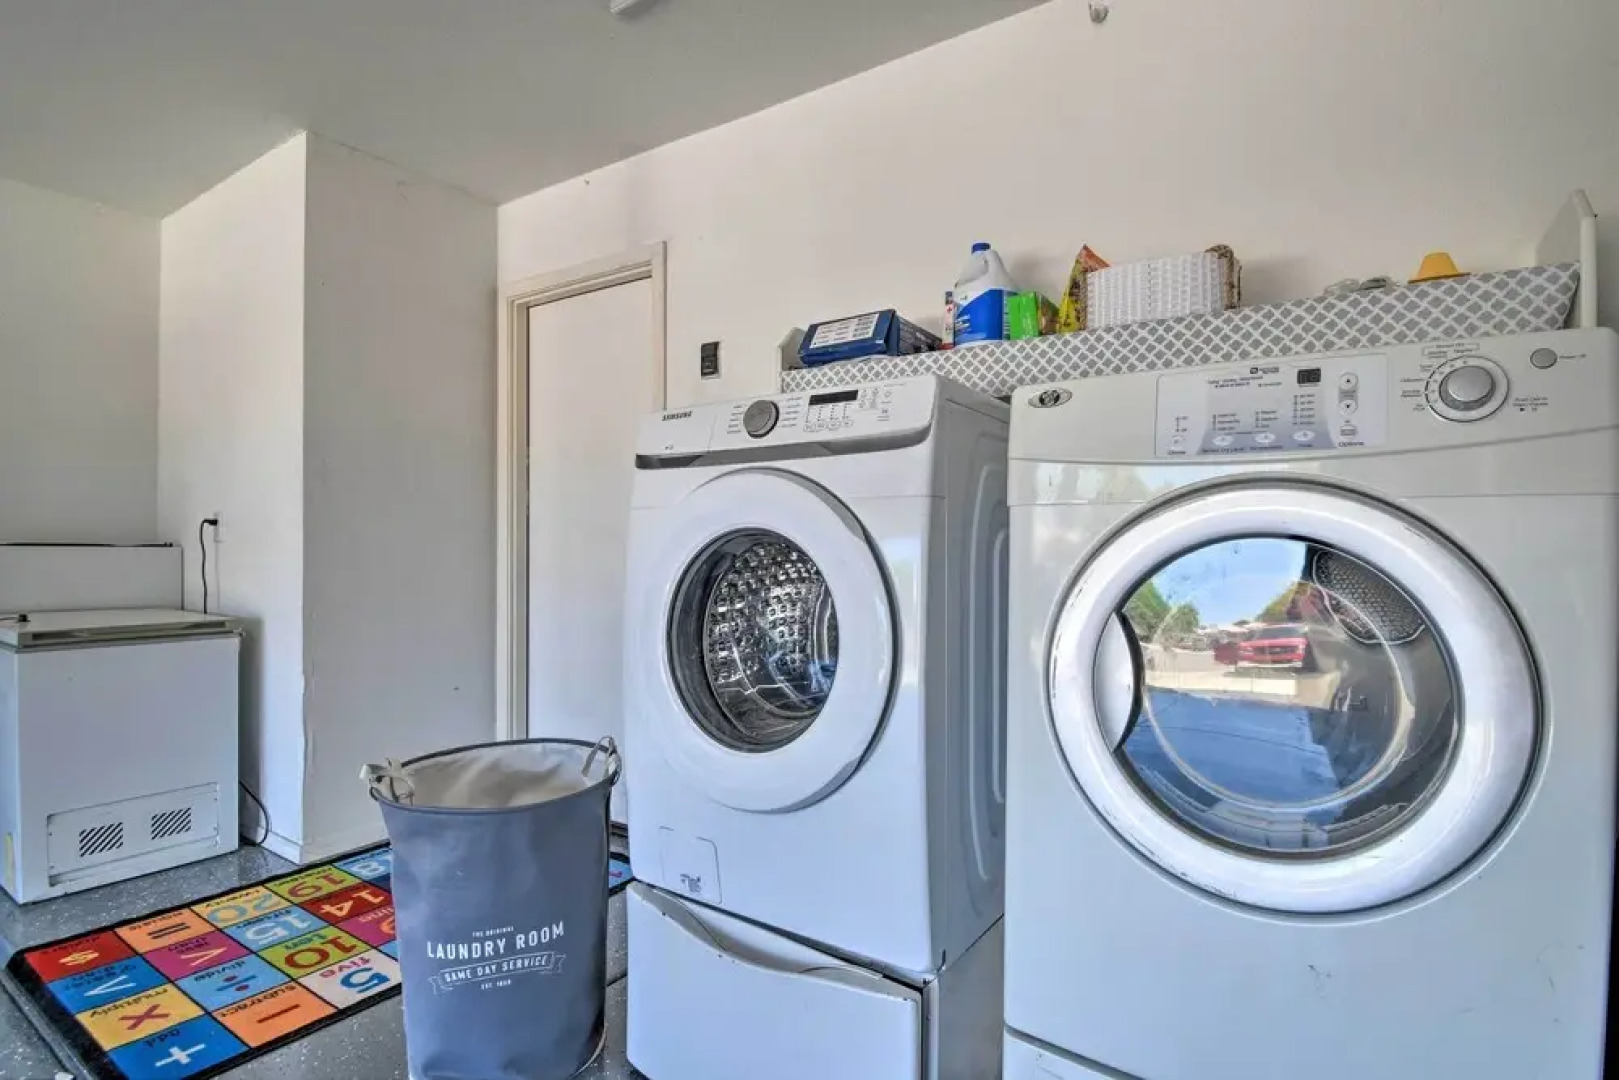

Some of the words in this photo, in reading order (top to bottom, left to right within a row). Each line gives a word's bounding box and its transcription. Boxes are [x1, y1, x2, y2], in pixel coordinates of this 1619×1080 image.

[287, 873, 343, 897] 19
[206, 893, 274, 924] 20
[320, 889, 384, 917] 14
[246, 914, 311, 945] 15
[427, 938, 506, 960] LAUNDRY
[516, 920, 565, 950] ROOM
[472, 930, 483, 938] THE
[485, 925, 514, 936] ORIGINAL
[284, 935, 357, 969] 10
[319, 956, 371, 979] five
[340, 966, 391, 995] 5
[444, 969, 472, 982] SAME
[477, 965, 497, 976] DAY
[501, 955, 549, 972] SERVICE
